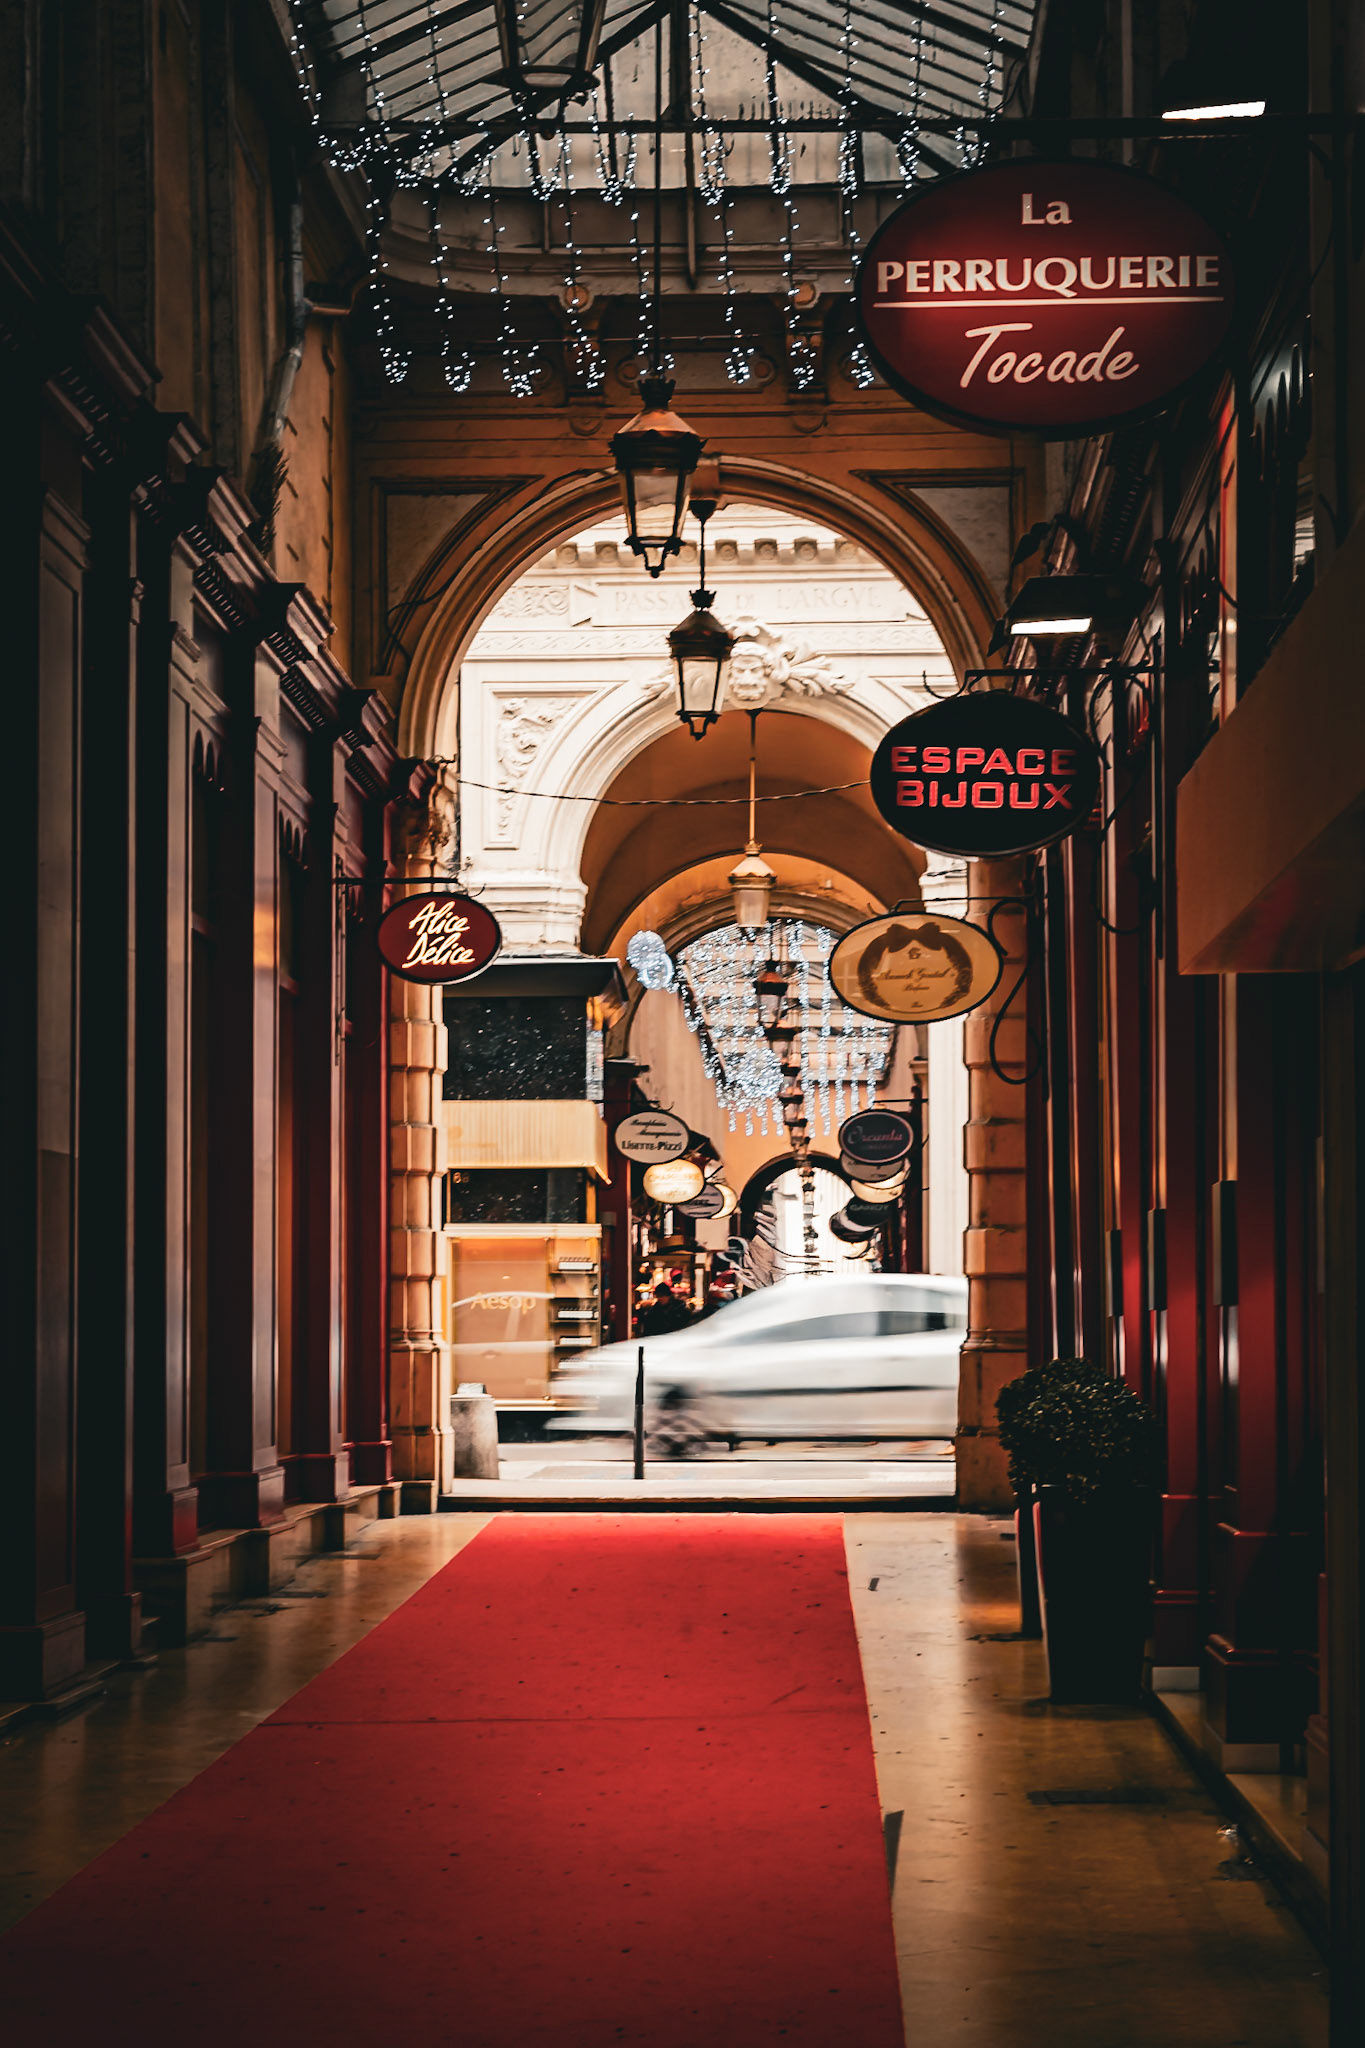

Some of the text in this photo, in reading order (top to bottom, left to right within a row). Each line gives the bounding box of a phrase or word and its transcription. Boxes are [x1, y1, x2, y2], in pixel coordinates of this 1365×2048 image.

[1021, 193, 1072, 225] La
[877, 255, 1219, 297] PERRUQUERIE
[959, 322, 1140, 388] Tocade
[614, 590, 719, 612] PASSA
[891, 746, 1077, 776] ESPACE
[896, 780, 1072, 810] BIJOUX
[408, 901, 470, 936] Alice
[401, 932, 476, 968] Délice
[470, 1292, 537, 1315] Aesop
